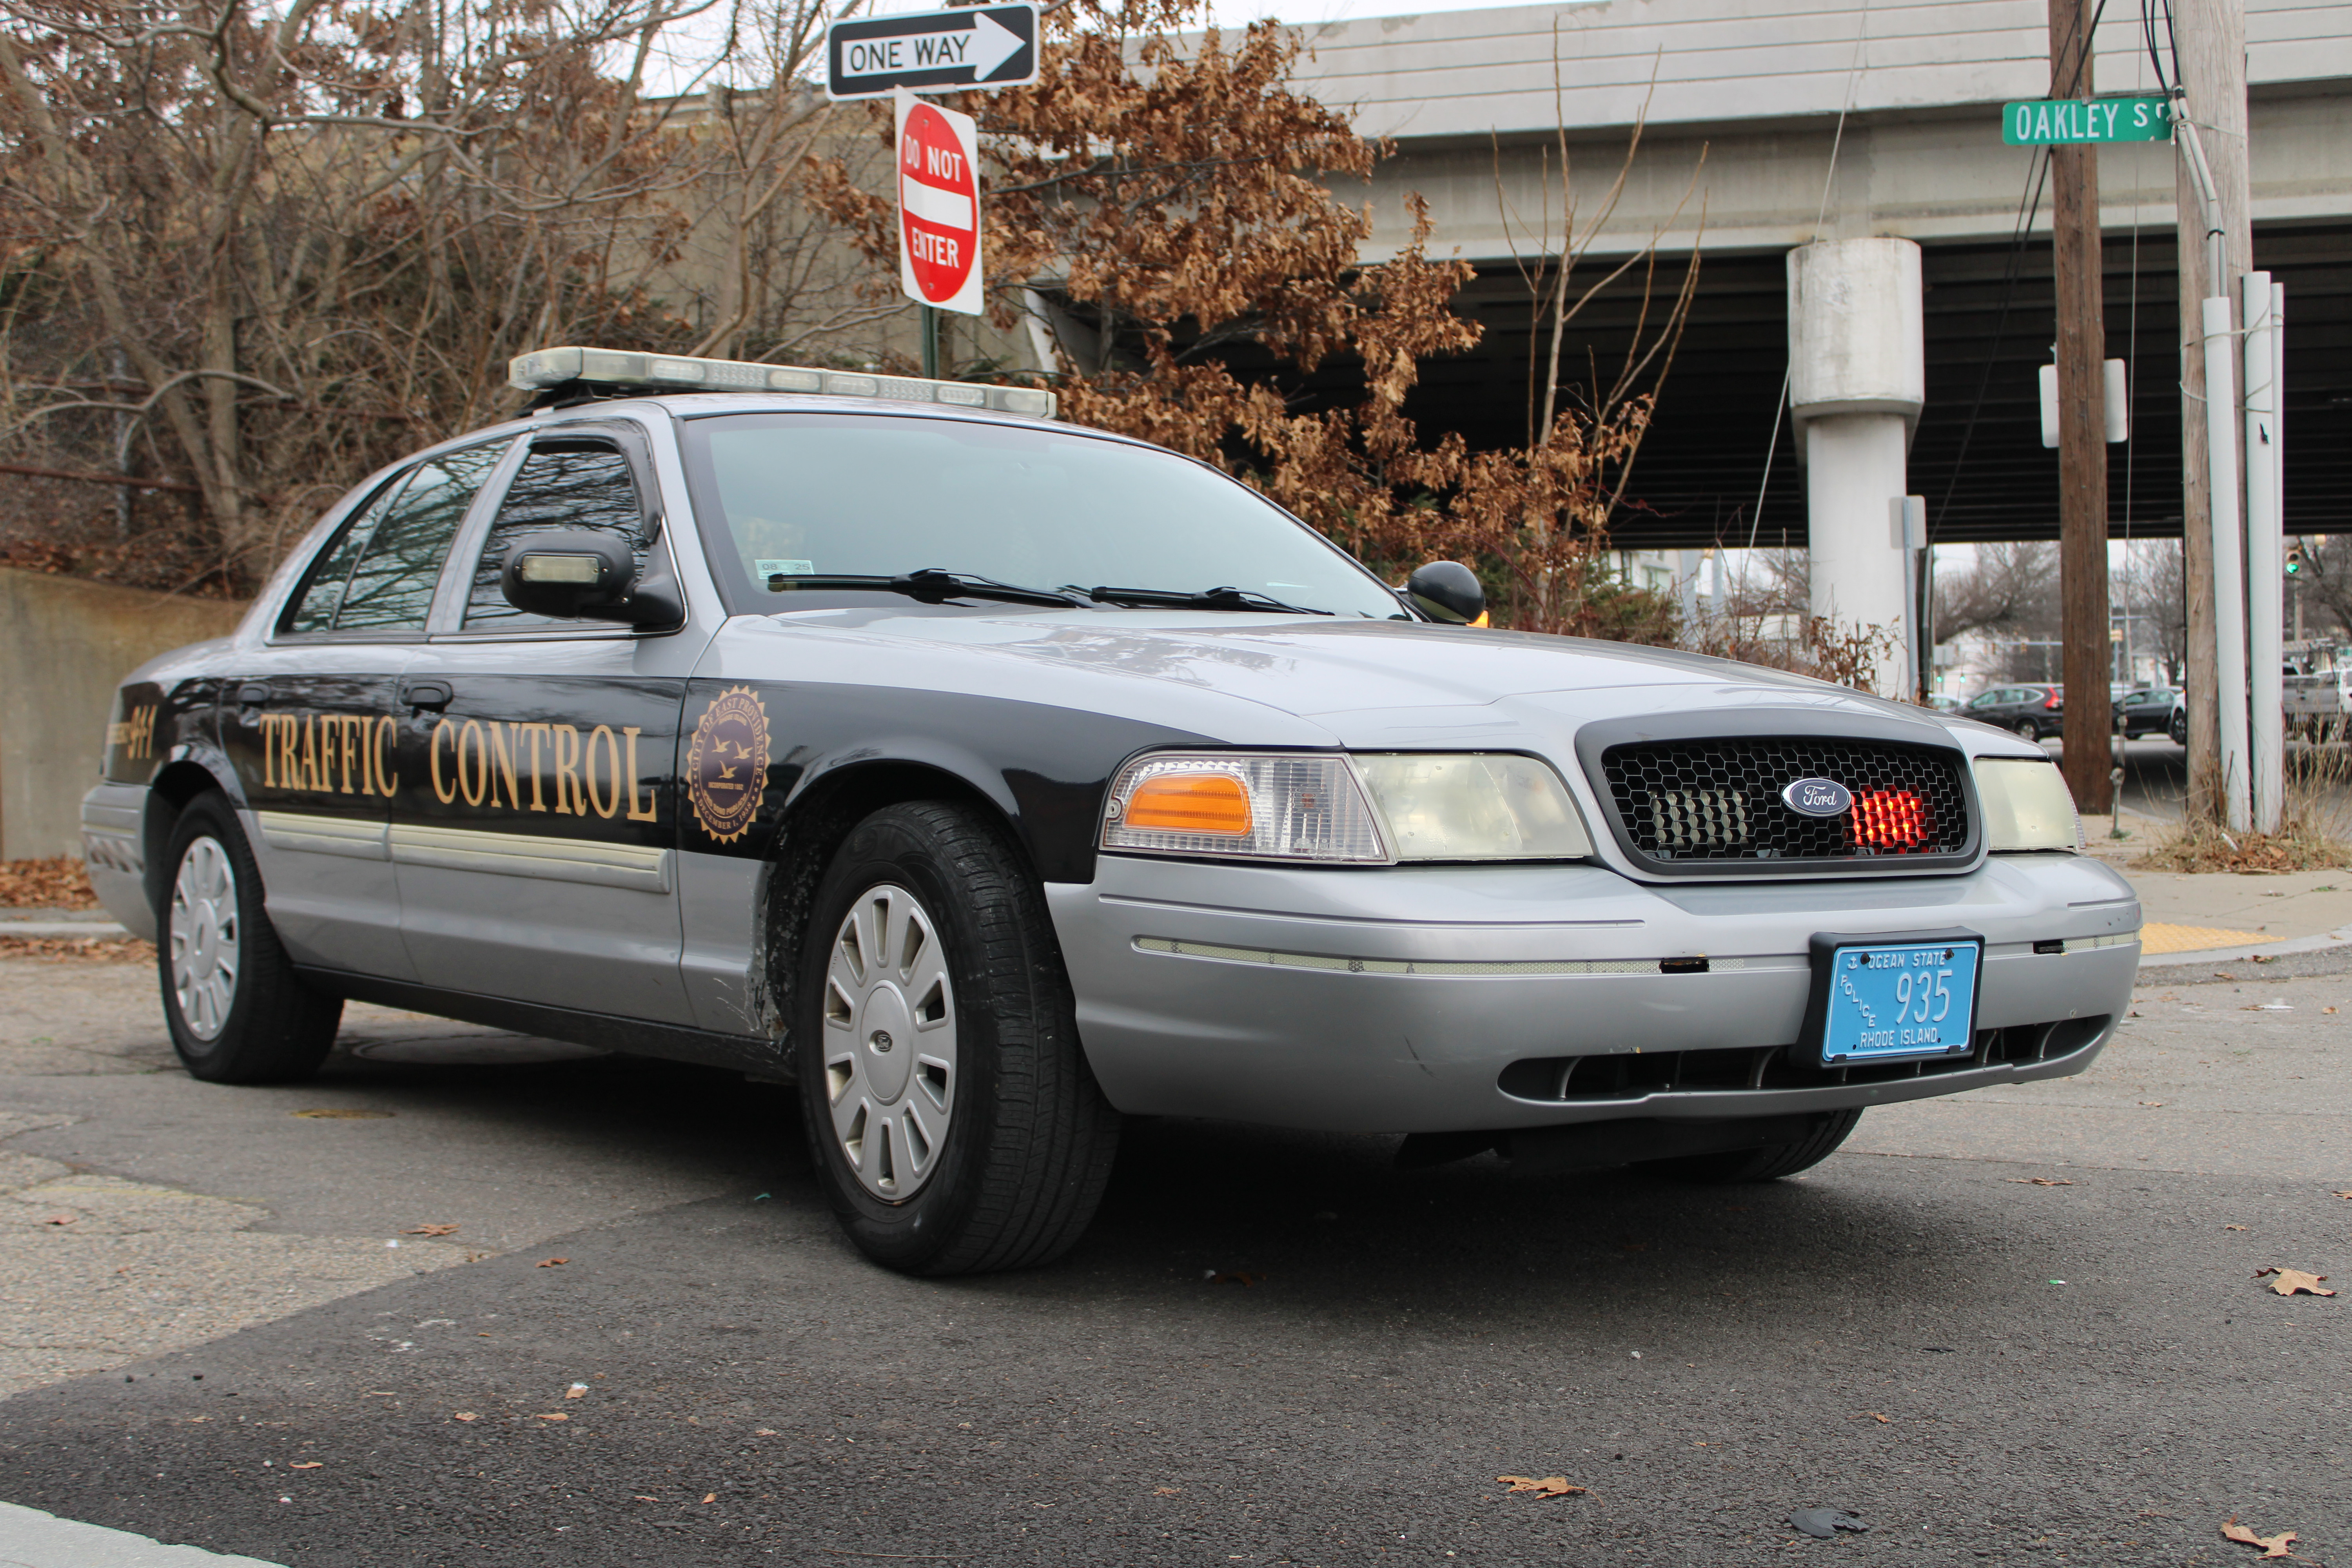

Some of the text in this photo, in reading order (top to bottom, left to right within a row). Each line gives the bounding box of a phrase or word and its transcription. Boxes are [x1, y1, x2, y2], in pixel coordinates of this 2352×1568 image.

[850, 34, 971, 71] ONE WAY
[2016, 103, 2119, 141] OAKLEY
[905, 134, 962, 182] DO NOT
[911, 227, 960, 268] ENTER
[692, 698, 764, 776] CITY OF EAST PROVIDENCE
[259, 713, 657, 822] TRAFFIC CONTROL
[698, 799, 731, 829] DECEMBER
[1803, 785, 1837, 806] Ford
[1868, 951, 1946, 969] OCEAN STATE
[1840, 975, 1876, 1027] POLICE
[1896, 969, 1953, 1025] 935
[1860, 1027, 1938, 1048] RHODE ISLAND
